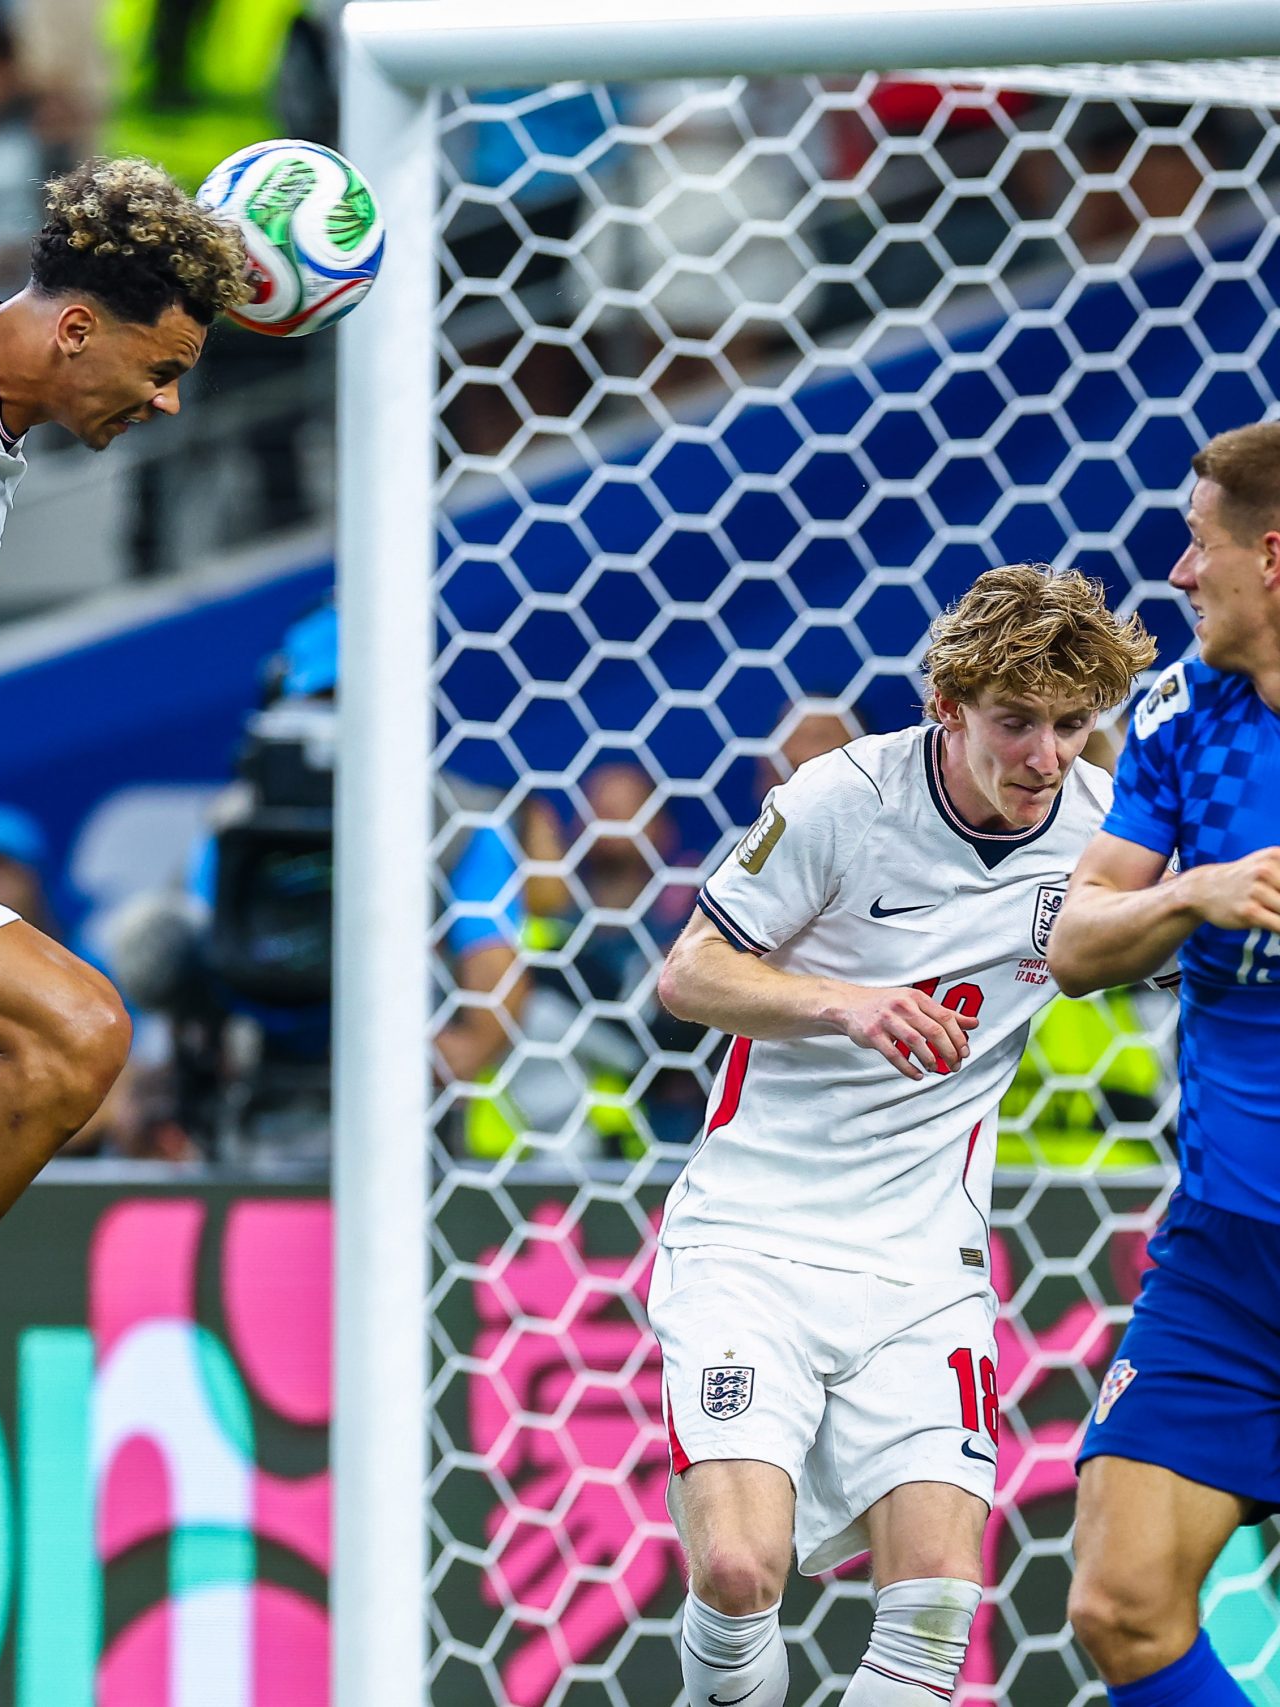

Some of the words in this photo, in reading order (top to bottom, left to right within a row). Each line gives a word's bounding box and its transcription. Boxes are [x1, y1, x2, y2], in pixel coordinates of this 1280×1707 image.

[1018, 958, 1051, 973] CROATI
[1014, 970, 1049, 985] 17.06.26
[947, 1347, 999, 1448] 18
